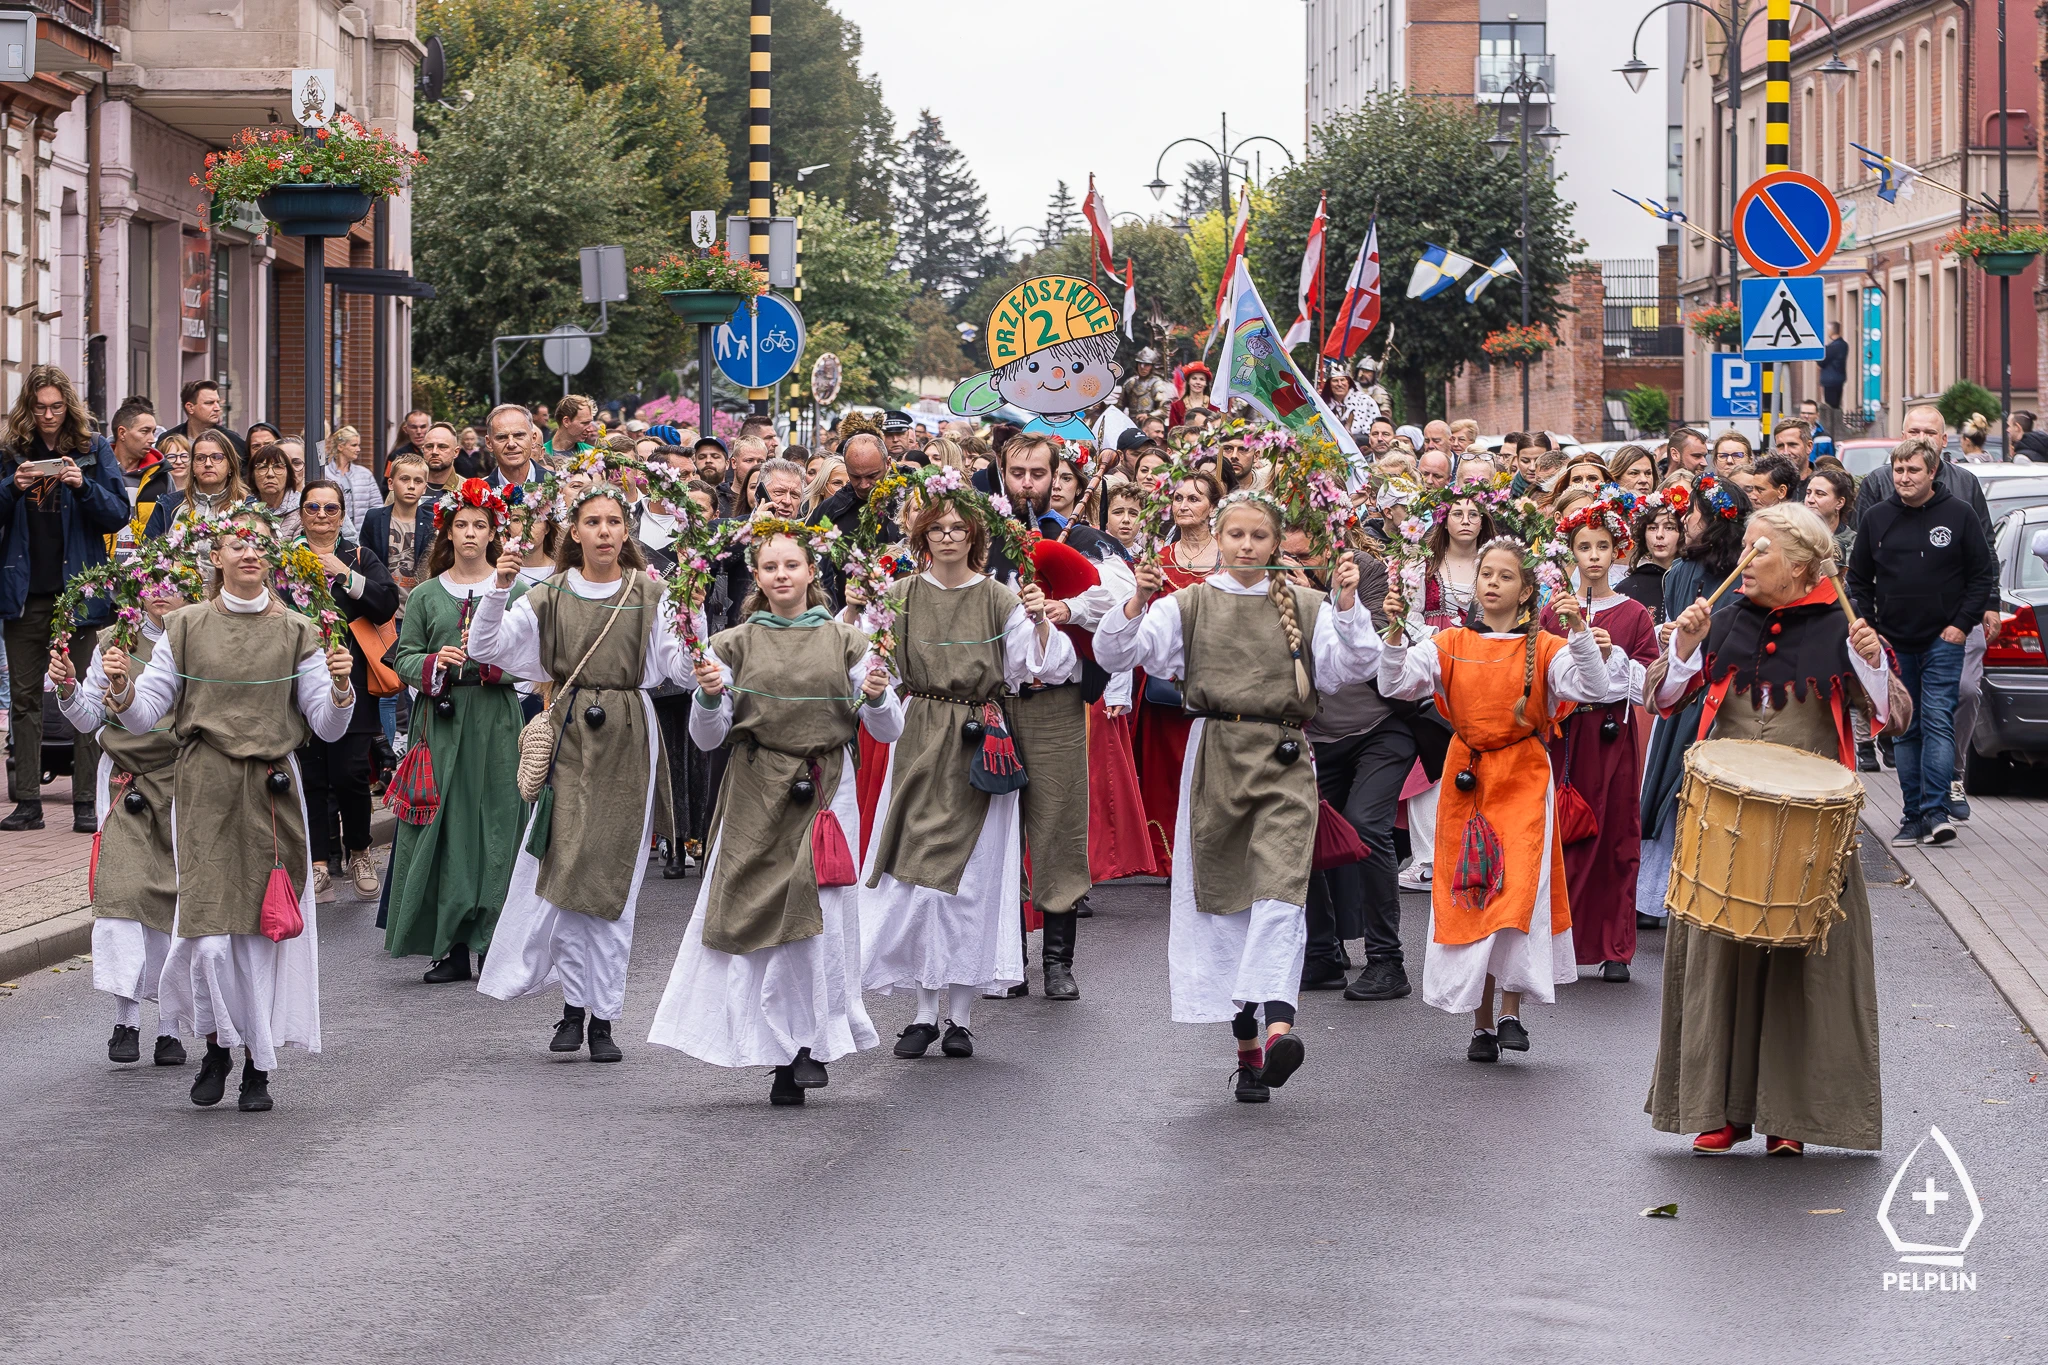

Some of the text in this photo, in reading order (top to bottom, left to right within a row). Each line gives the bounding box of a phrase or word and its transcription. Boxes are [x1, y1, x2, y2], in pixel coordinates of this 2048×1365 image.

[996, 279, 1109, 357] PRZEDSZKOLE
[1028, 309, 1061, 347] 2
[1722, 358, 1752, 399] P
